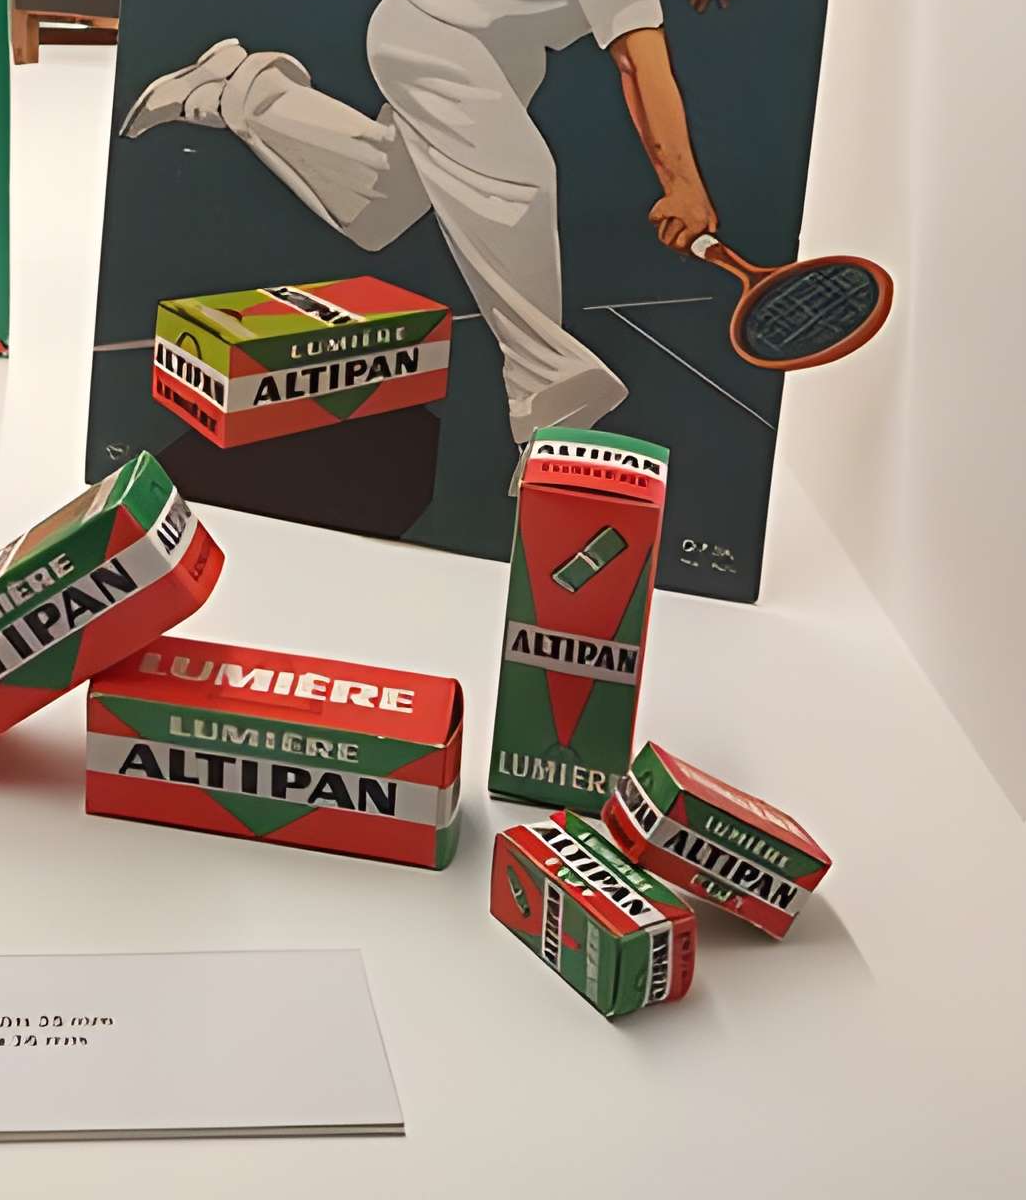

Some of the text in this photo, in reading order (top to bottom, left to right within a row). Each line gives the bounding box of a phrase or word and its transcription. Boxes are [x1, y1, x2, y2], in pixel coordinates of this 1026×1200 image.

[253, 347, 420, 406] ALTIPAN
[511, 628, 638, 673] ALTIPAN
[118, 743, 398, 826] ALTIPAN
[663, 828, 797, 910] ALTIPAN
